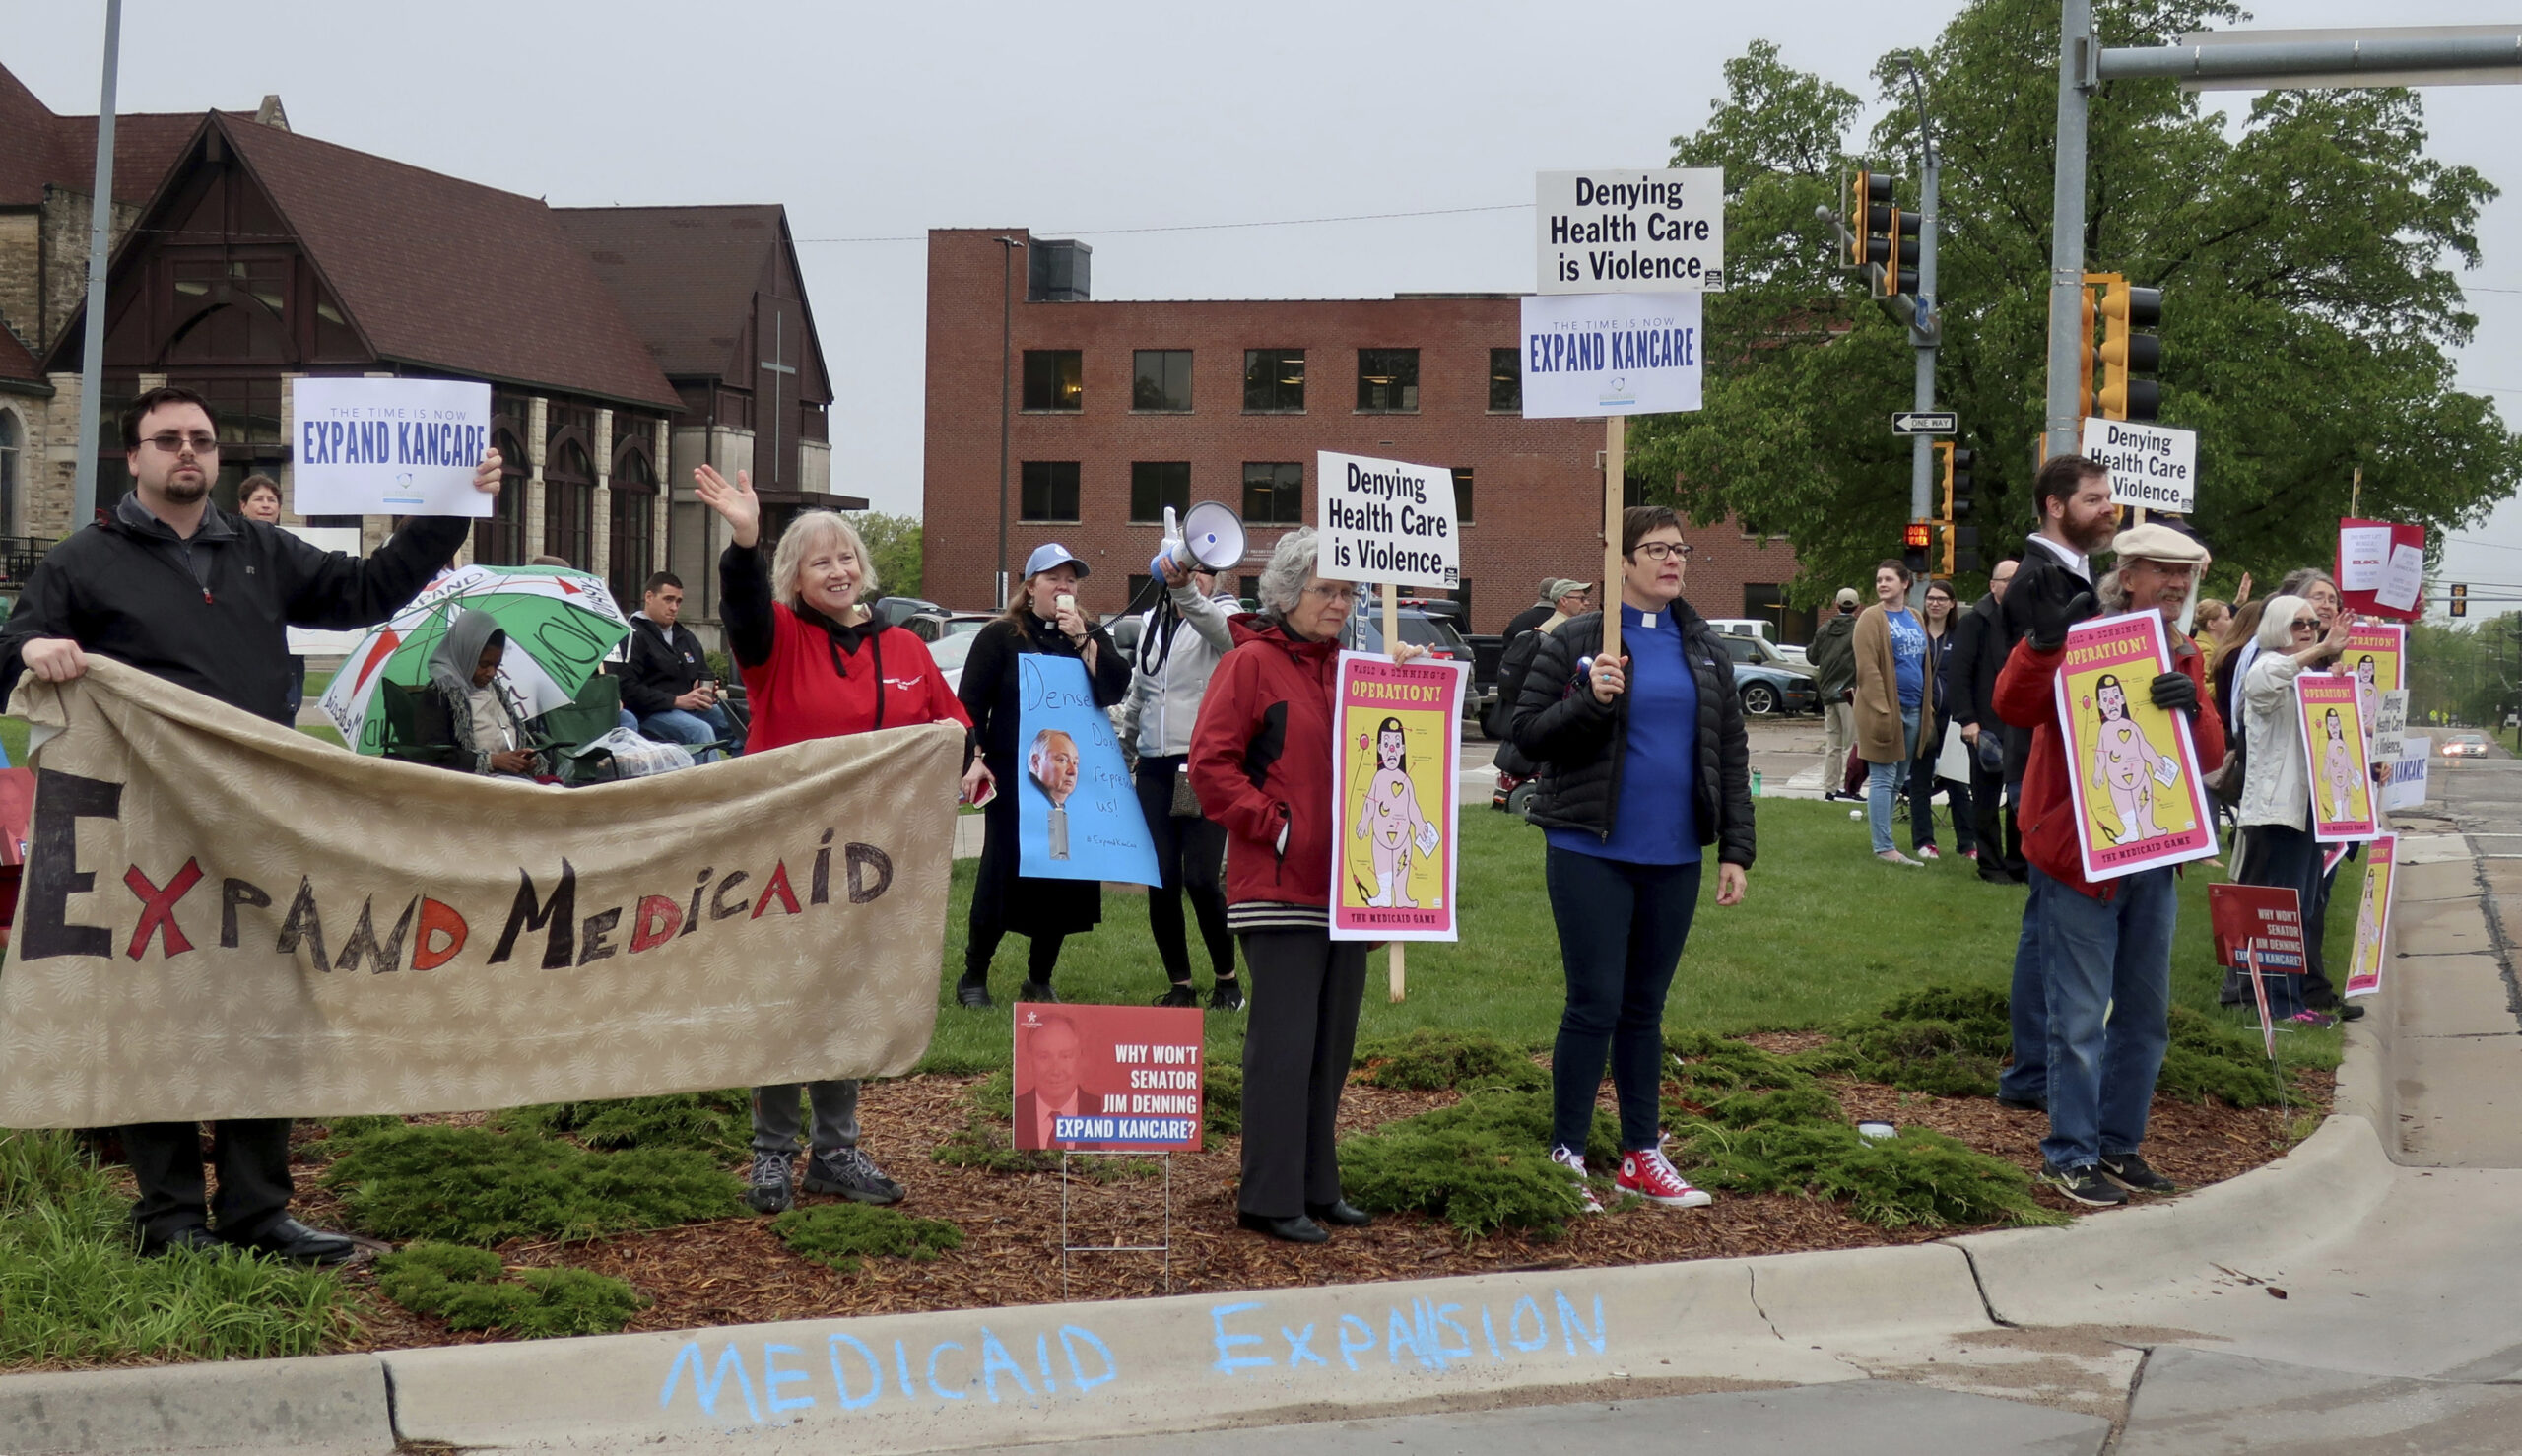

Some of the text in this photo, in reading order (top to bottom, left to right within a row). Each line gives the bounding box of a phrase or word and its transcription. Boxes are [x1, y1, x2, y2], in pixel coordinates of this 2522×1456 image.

[1576, 175, 1683, 211] Denying
[1551, 213, 1709, 244] Health Care
[1559, 250, 1702, 282] is Violence
[1553, 317, 1675, 330] THE TIME IS NOW
[1530, 328, 1694, 372] EXPAND KANCARE
[330, 408, 467, 421] THE TIME IS NOW
[1912, 419, 1929, 428] ONE
[303, 421, 485, 467] EXPAND KANCARE
[2108, 425, 2172, 456] Denying
[2091, 447, 2186, 479] Health Care
[1348, 462, 1427, 504] Denying
[2113, 476, 2179, 502] Violence
[1330, 498, 1447, 538] Health Care
[1335, 537, 1442, 574] is Violence
[2066, 635, 2148, 666] OPERATION!
[1023, 657, 1093, 711] Dense
[1391, 669, 1446, 680] DENNING'S
[1352, 680, 1442, 701] OPERATION!
[2305, 688, 2351, 698] OPERATION!
[1096, 798, 1117, 818] us!
[2102, 836, 2191, 863] THE MEDICAID GAME
[20, 767, 470, 974] EXPAND
[1369, 914, 1411, 924] MEDICAID
[1413, 914, 1436, 924] GAME
[2258, 908, 2274, 920] WHY
[2267, 924, 2299, 938] SENATOR
[2270, 939, 2301, 952] DENNING
[2265, 953, 2302, 967] KANCARE?
[1115, 1044, 1198, 1064] WHY WON'T
[1131, 1070, 1197, 1090] SENATOR
[1102, 1094, 1197, 1114] JIM DENNING
[1056, 1119, 1196, 1139] EXPAND KANCARE?
[659, 1322, 1117, 1423] MEDICAID
